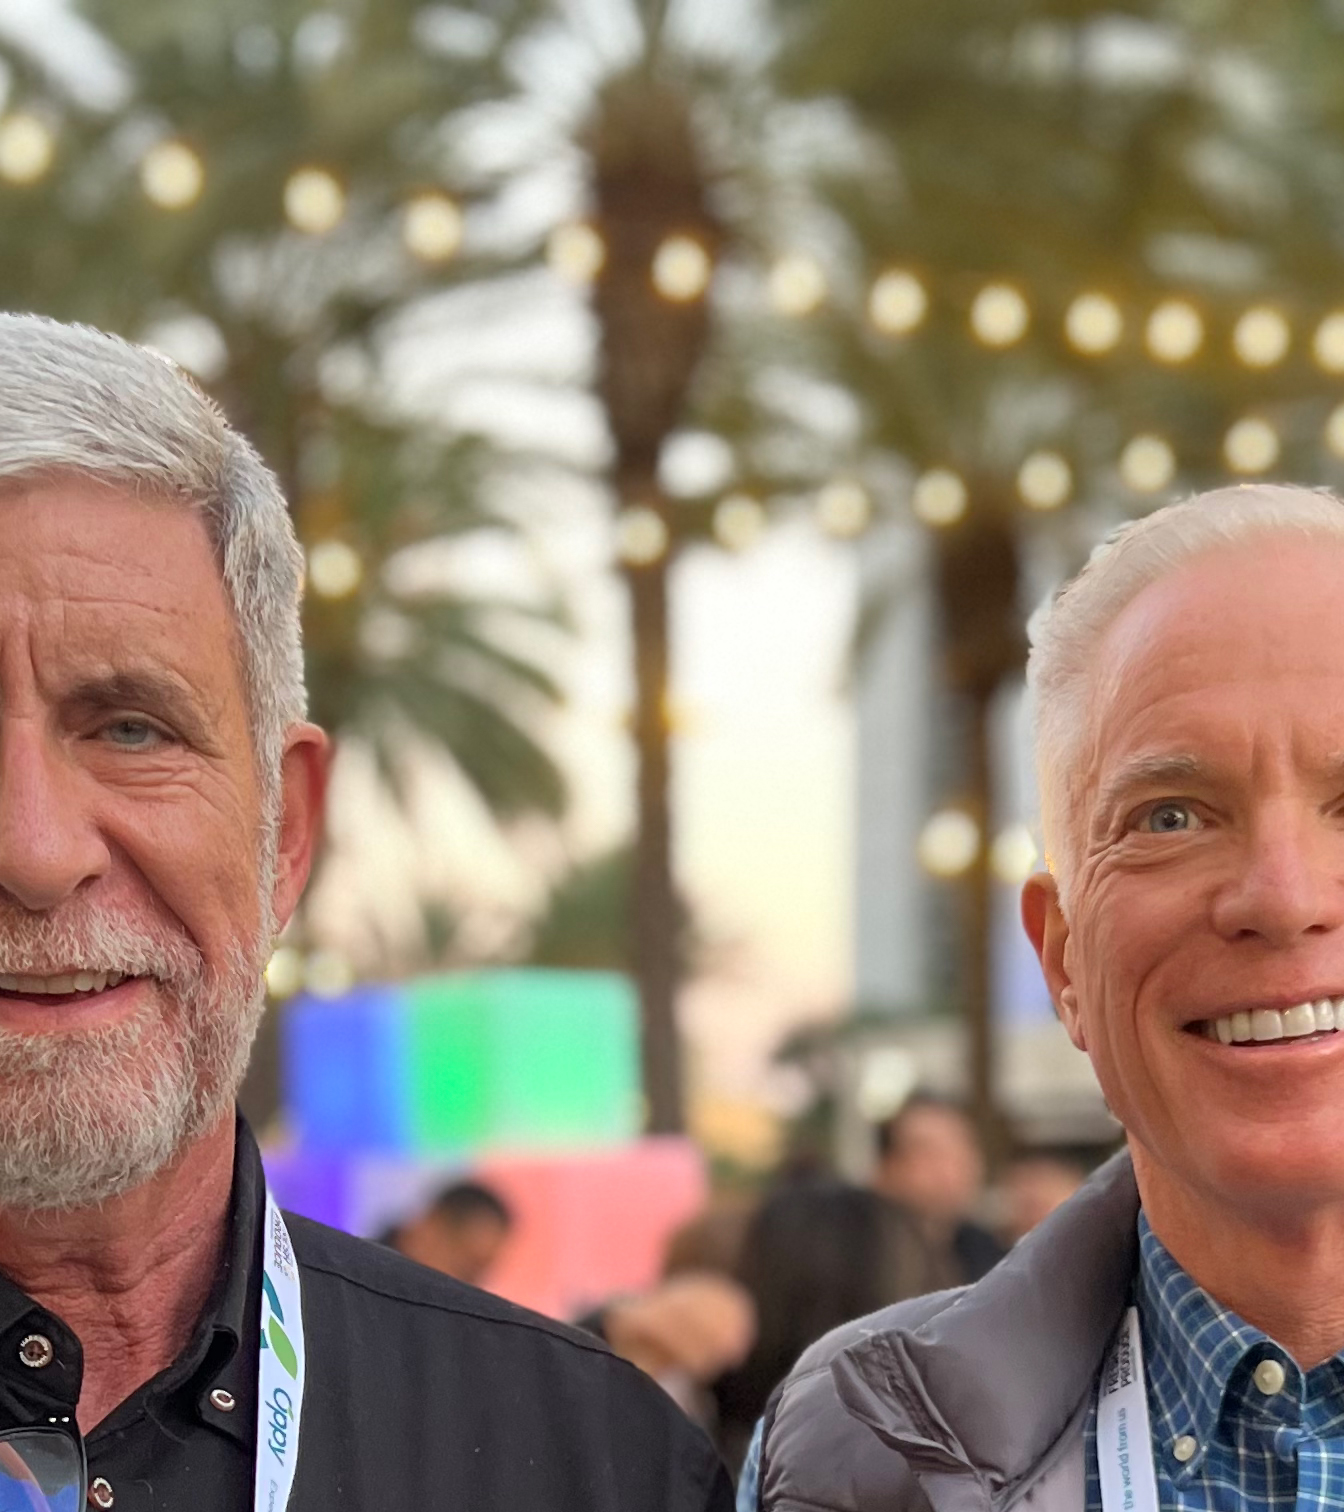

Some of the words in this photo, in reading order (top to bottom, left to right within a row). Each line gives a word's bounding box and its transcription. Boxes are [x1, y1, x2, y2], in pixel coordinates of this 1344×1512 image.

[265, 1388, 293, 1467] Oppy
[1117, 1407, 1126, 1422] us
[1117, 1423, 1128, 1452] from
[1118, 1453, 1131, 1488] world
[1123, 1489, 1134, 1511] the
